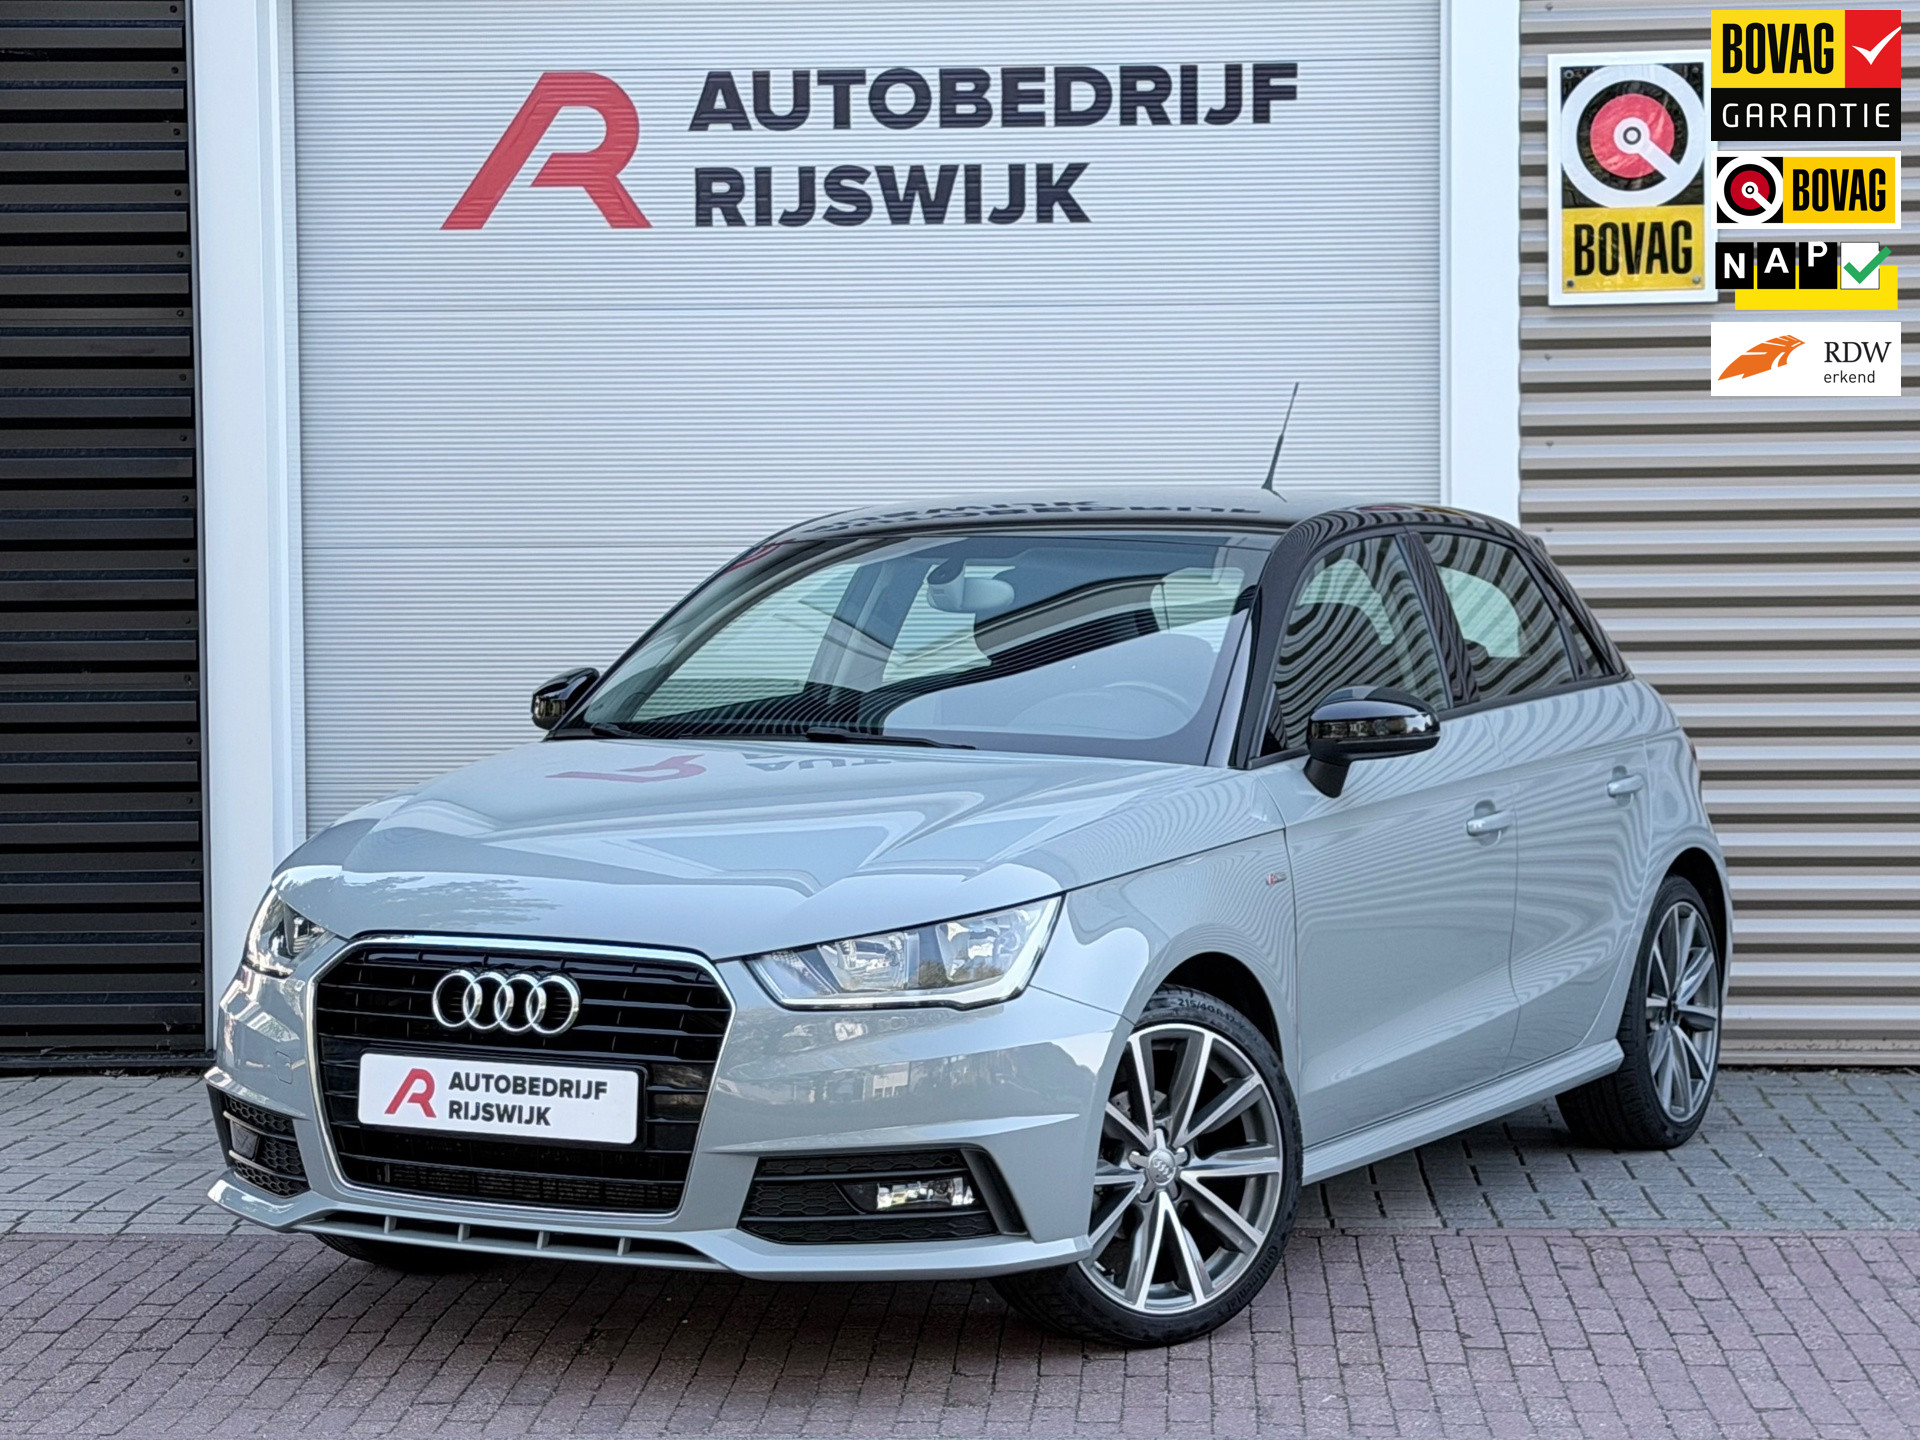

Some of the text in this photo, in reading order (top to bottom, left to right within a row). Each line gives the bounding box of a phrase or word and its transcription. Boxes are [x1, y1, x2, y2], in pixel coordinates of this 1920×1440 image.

[688, 62, 1298, 131] AUTOBEDRIJF
[694, 162, 1091, 228] RIJSWIJK
[1573, 219, 1693, 277] BOVAG
[448, 1070, 608, 1101] AUTOBEDRIJF
[448, 1099, 552, 1127] RIJSWIJK
